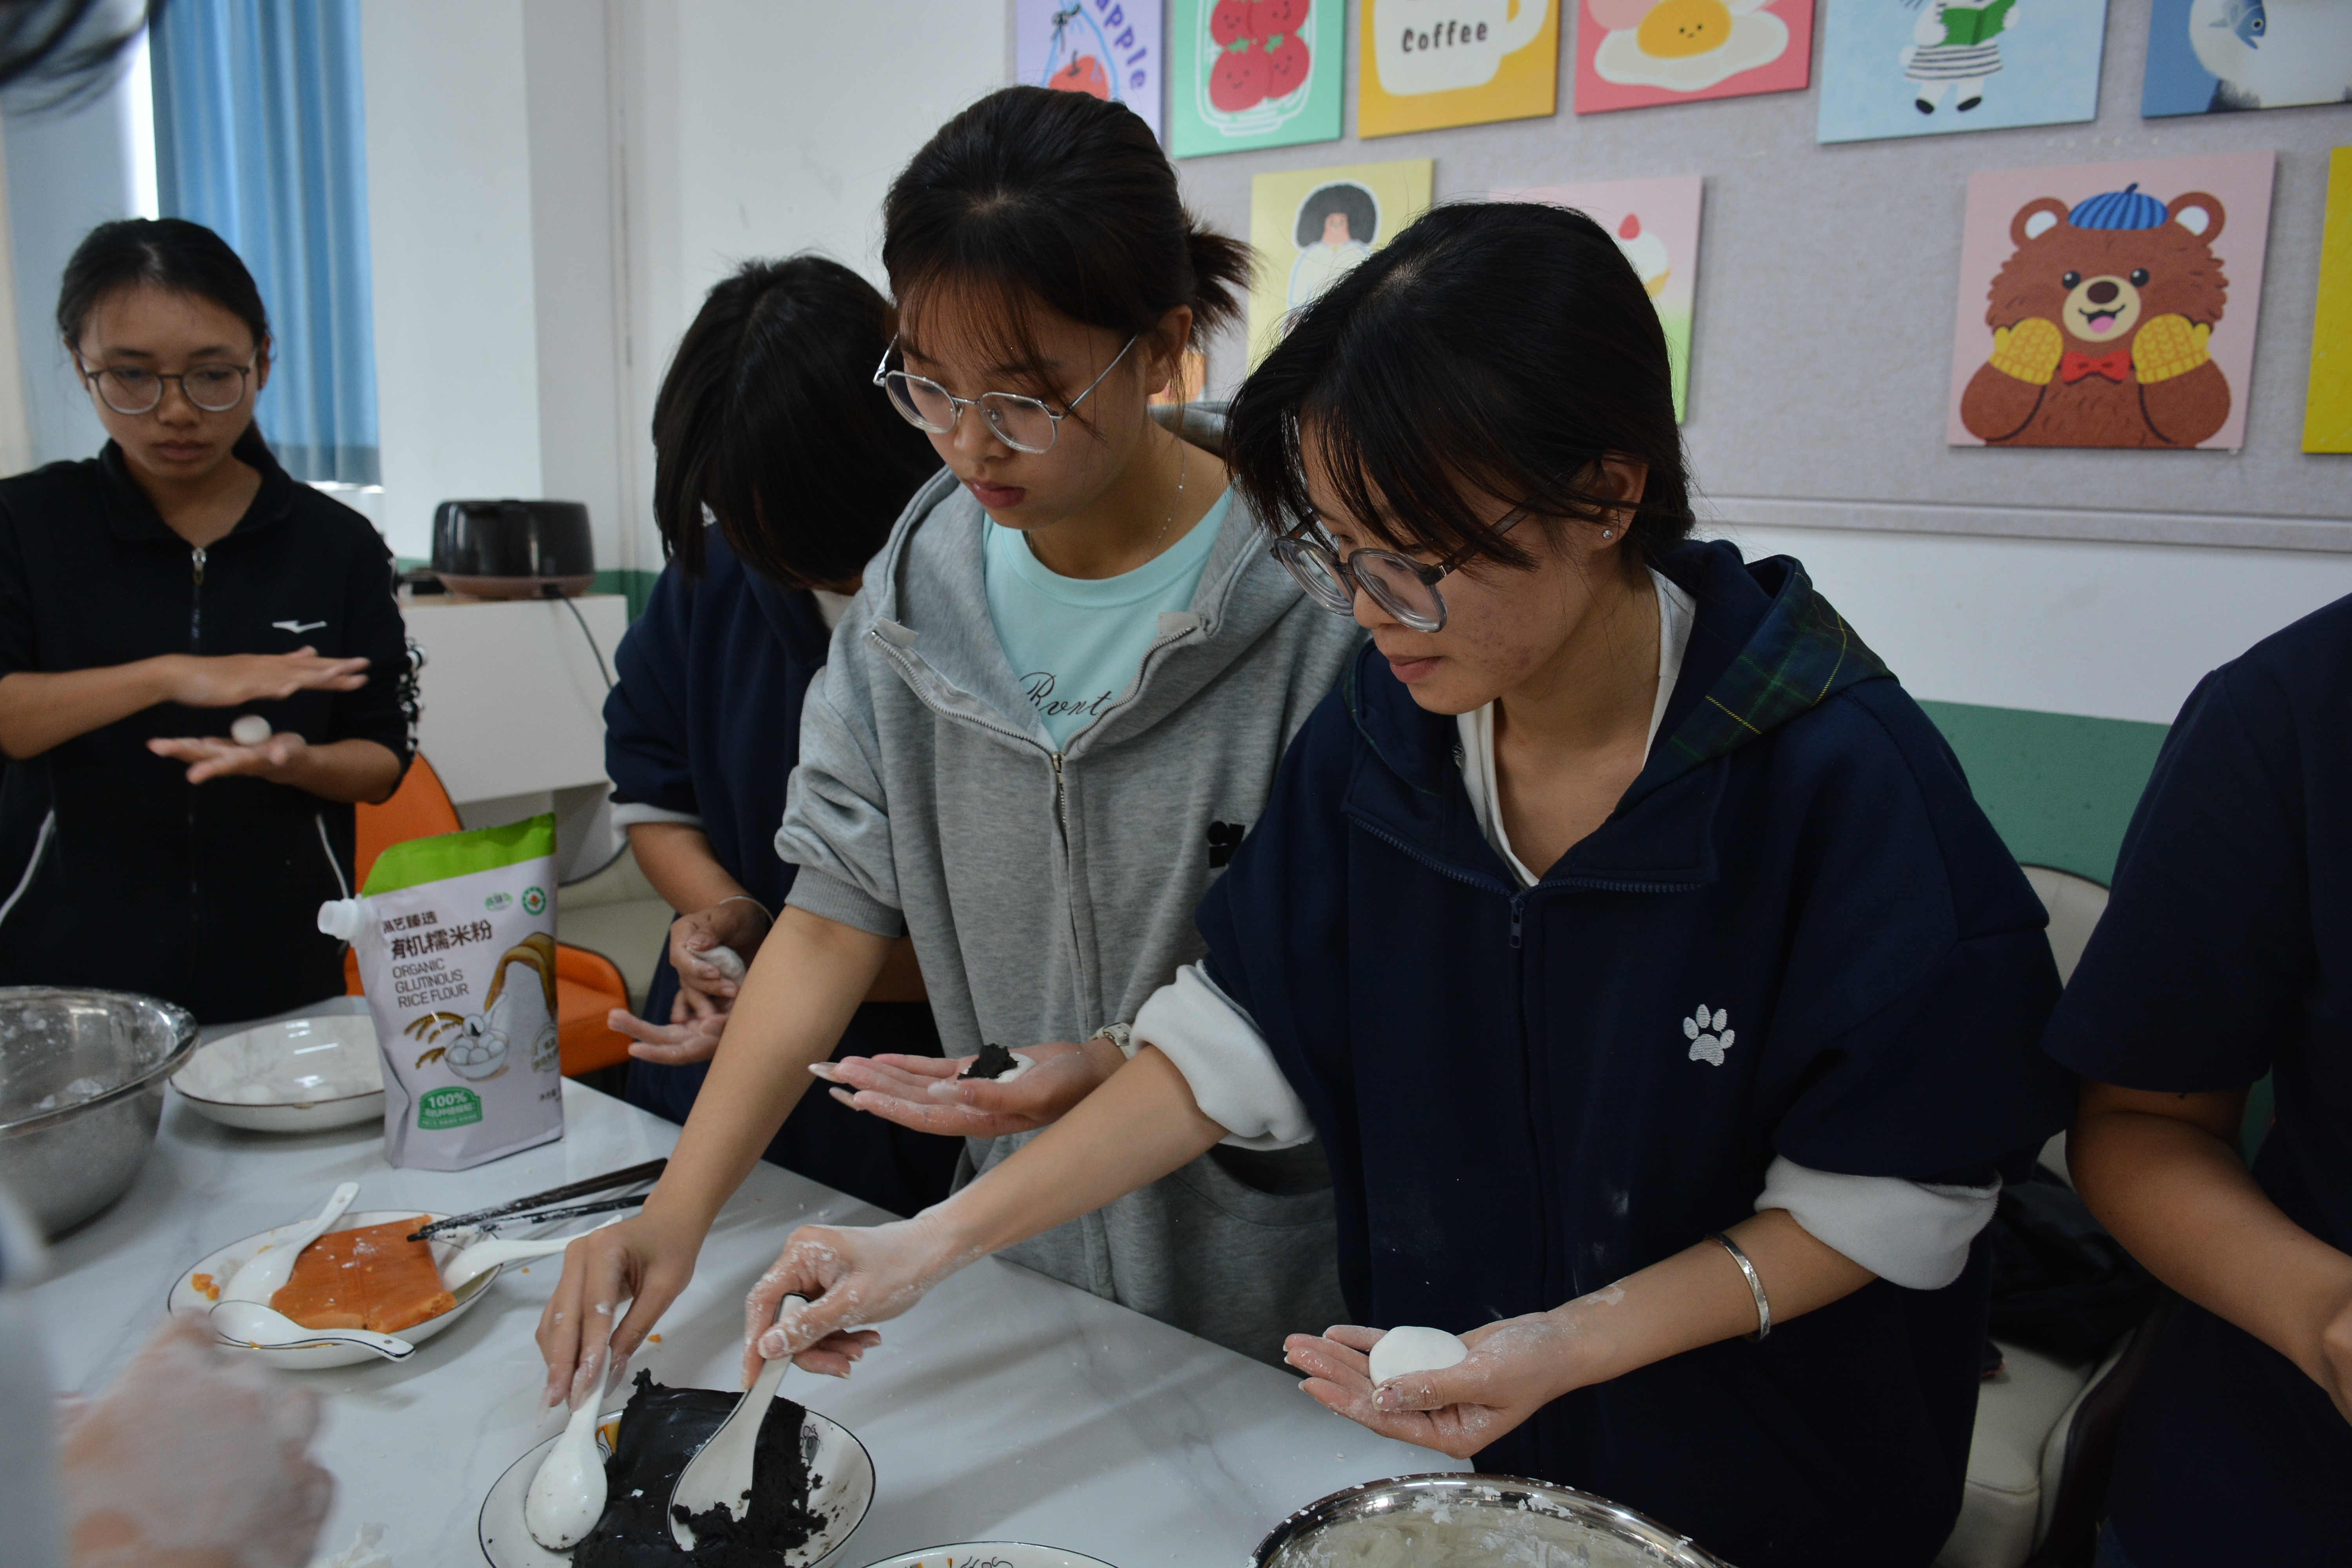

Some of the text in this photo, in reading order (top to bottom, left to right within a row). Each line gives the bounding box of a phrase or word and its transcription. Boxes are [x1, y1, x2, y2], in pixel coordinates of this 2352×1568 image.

[1402, 20, 1486, 52] Coffee
[392, 920, 492, 960] 有机糯米粉
[393, 958, 445, 979] ORGANIC
[396, 969, 463, 993] GLUTINOUS
[398, 983, 469, 1008] RICE FLOUR
[428, 1092, 467, 1108] 100%
